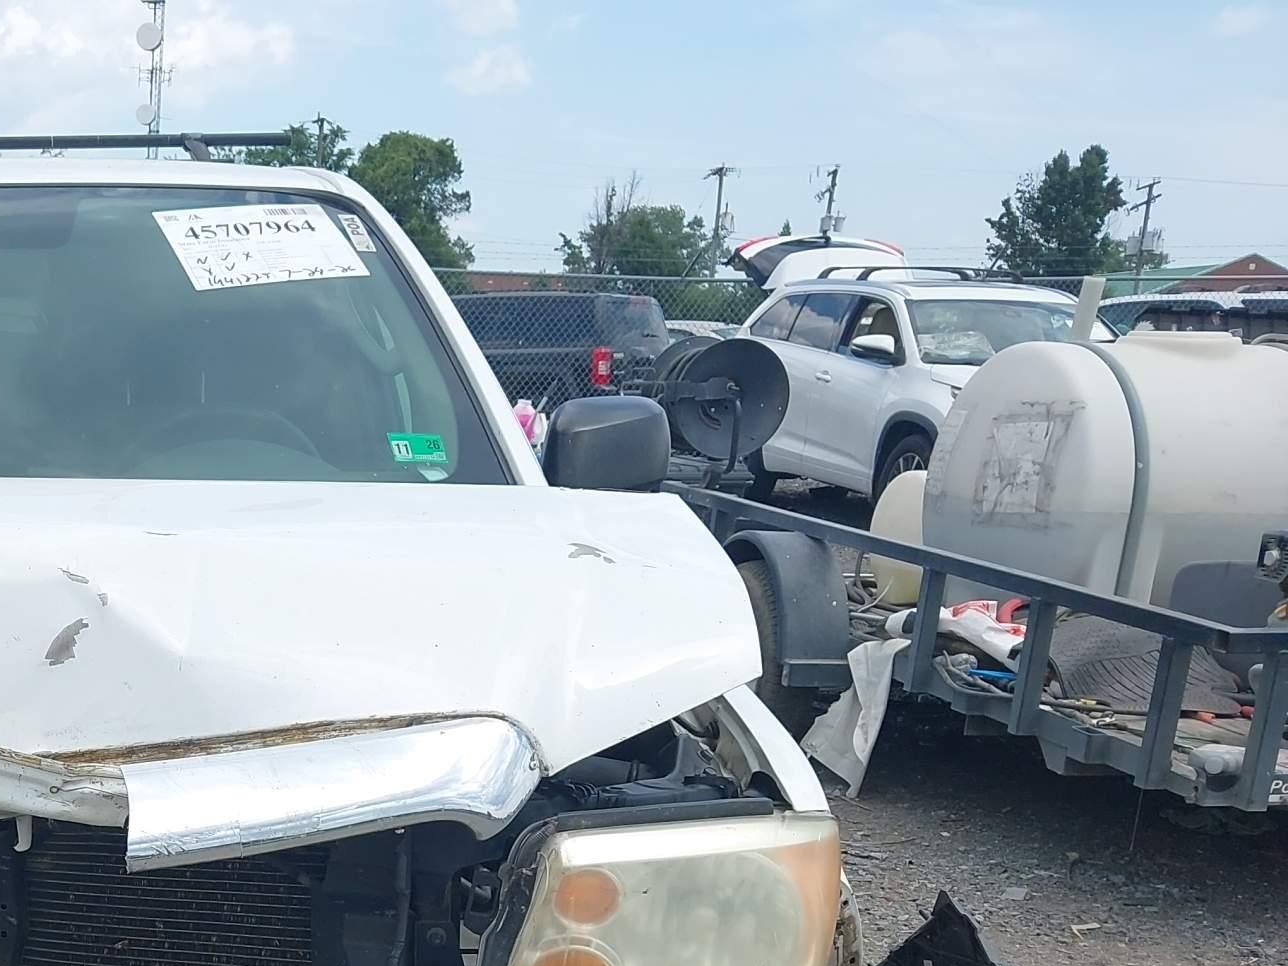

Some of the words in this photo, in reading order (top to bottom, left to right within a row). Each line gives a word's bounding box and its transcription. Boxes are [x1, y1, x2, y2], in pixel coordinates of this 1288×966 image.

[184, 219, 316, 240] 45707964
[394, 442, 410, 457] 11
[425, 439, 441, 450] 26
